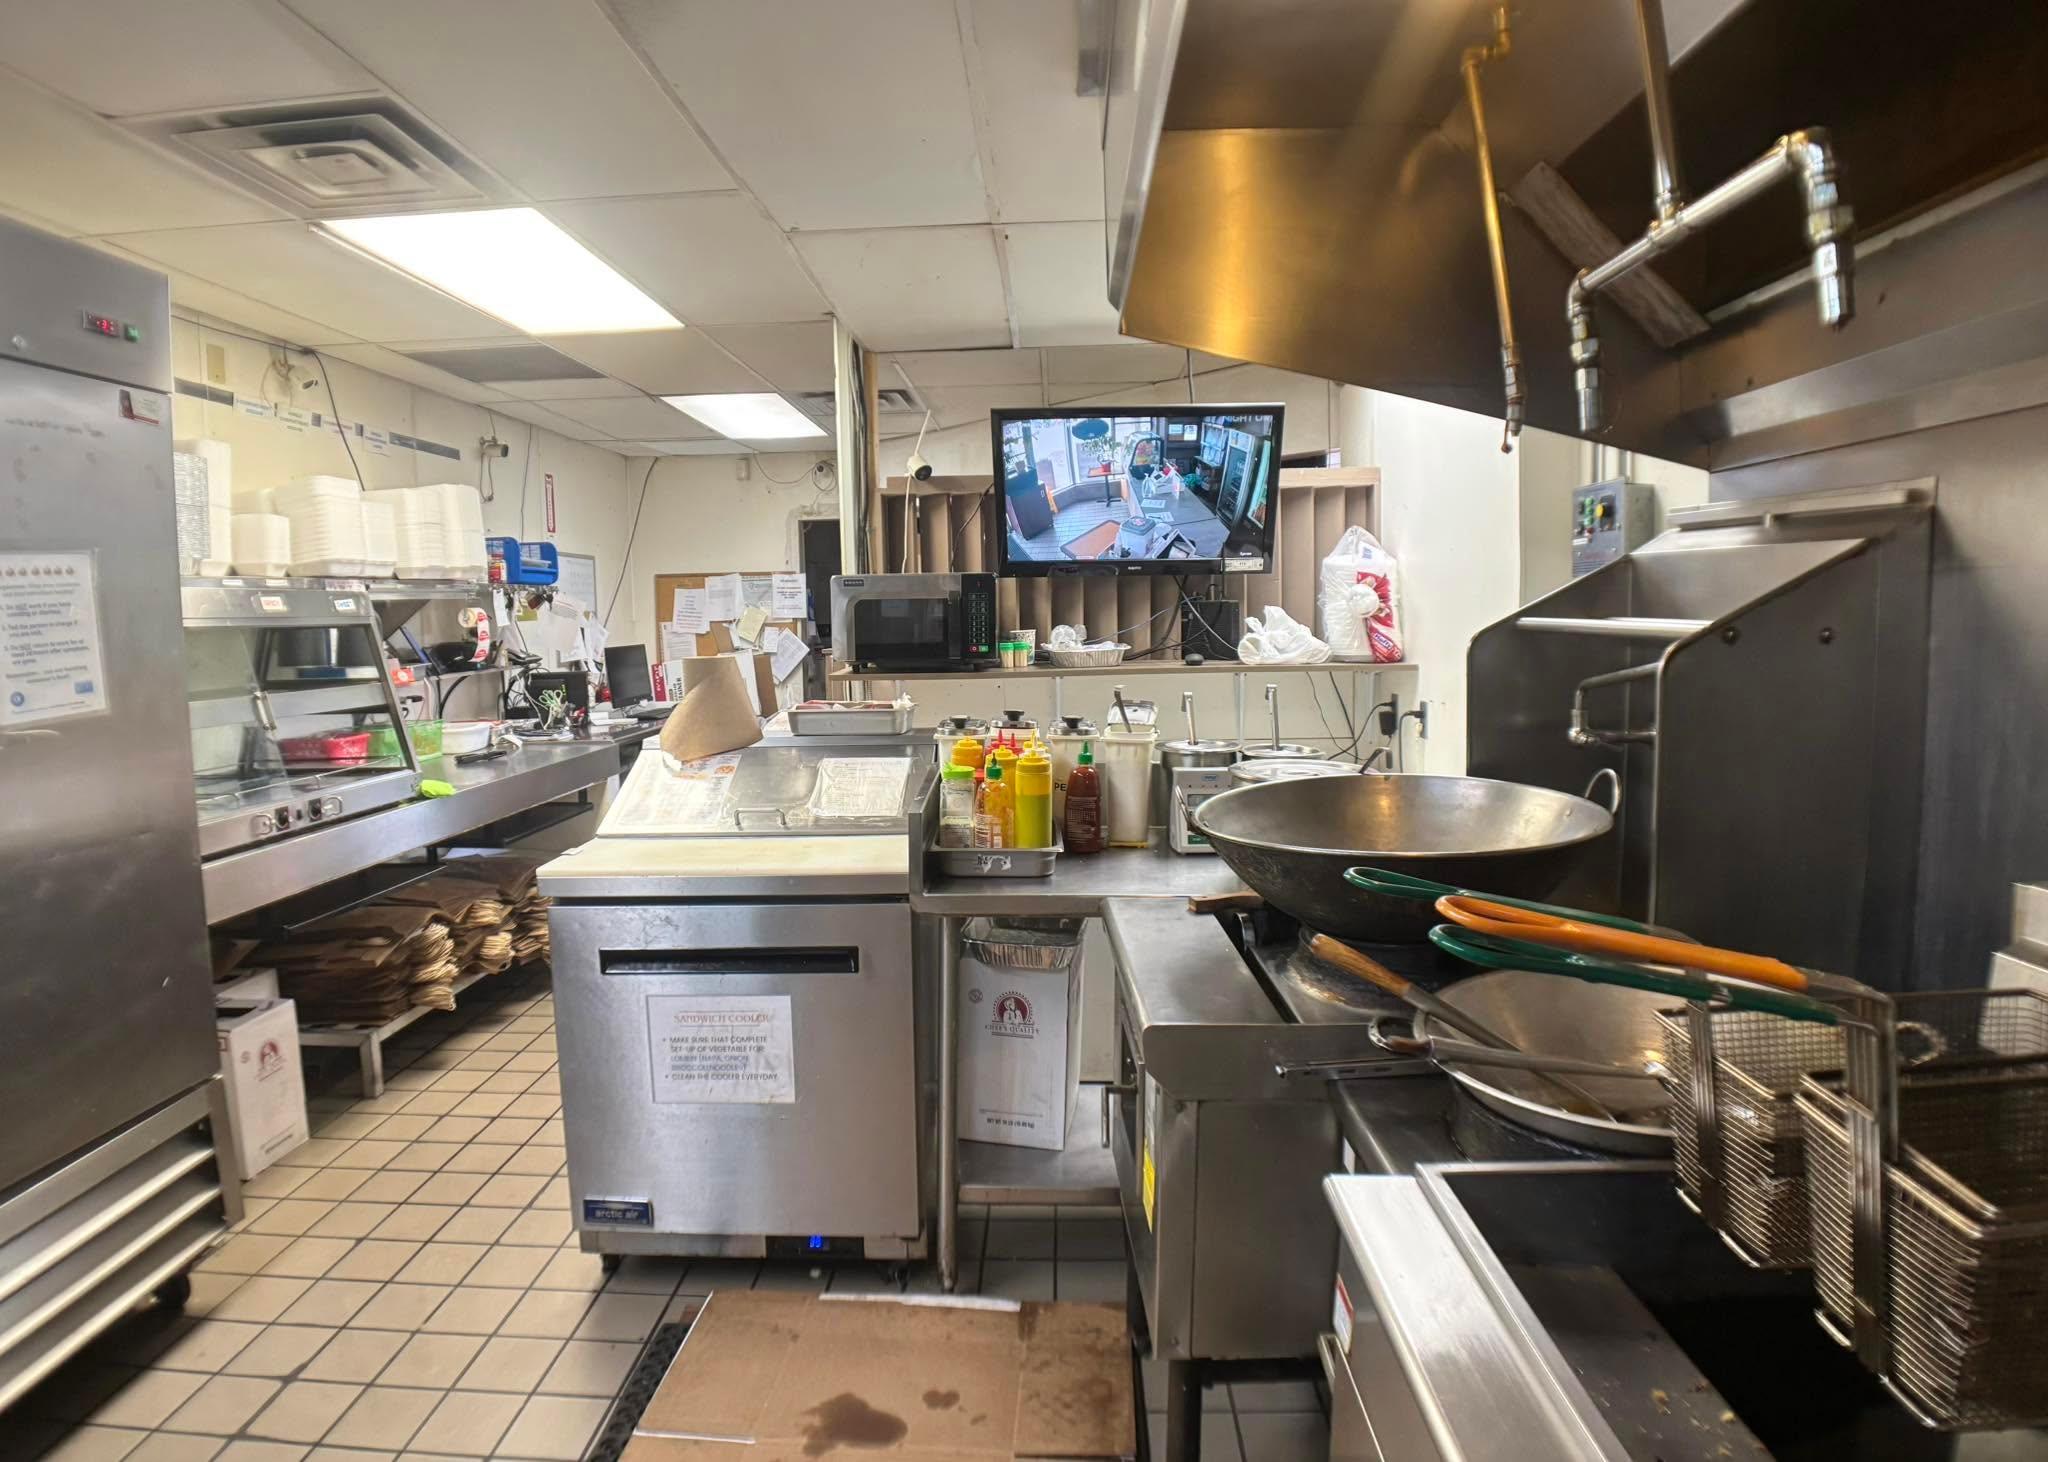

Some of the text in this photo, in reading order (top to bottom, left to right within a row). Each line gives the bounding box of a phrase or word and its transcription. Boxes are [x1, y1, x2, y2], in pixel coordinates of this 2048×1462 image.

[1055, 782, 1067, 792] PE
[673, 1014, 769, 1024] SANDWICH COOLER
[731, 1035, 768, 1043] COMPLETE
[672, 1073, 696, 1081] CLEAN
[711, 1073, 740, 1081] COOLER
[594, 1209, 640, 1219] arctic air
